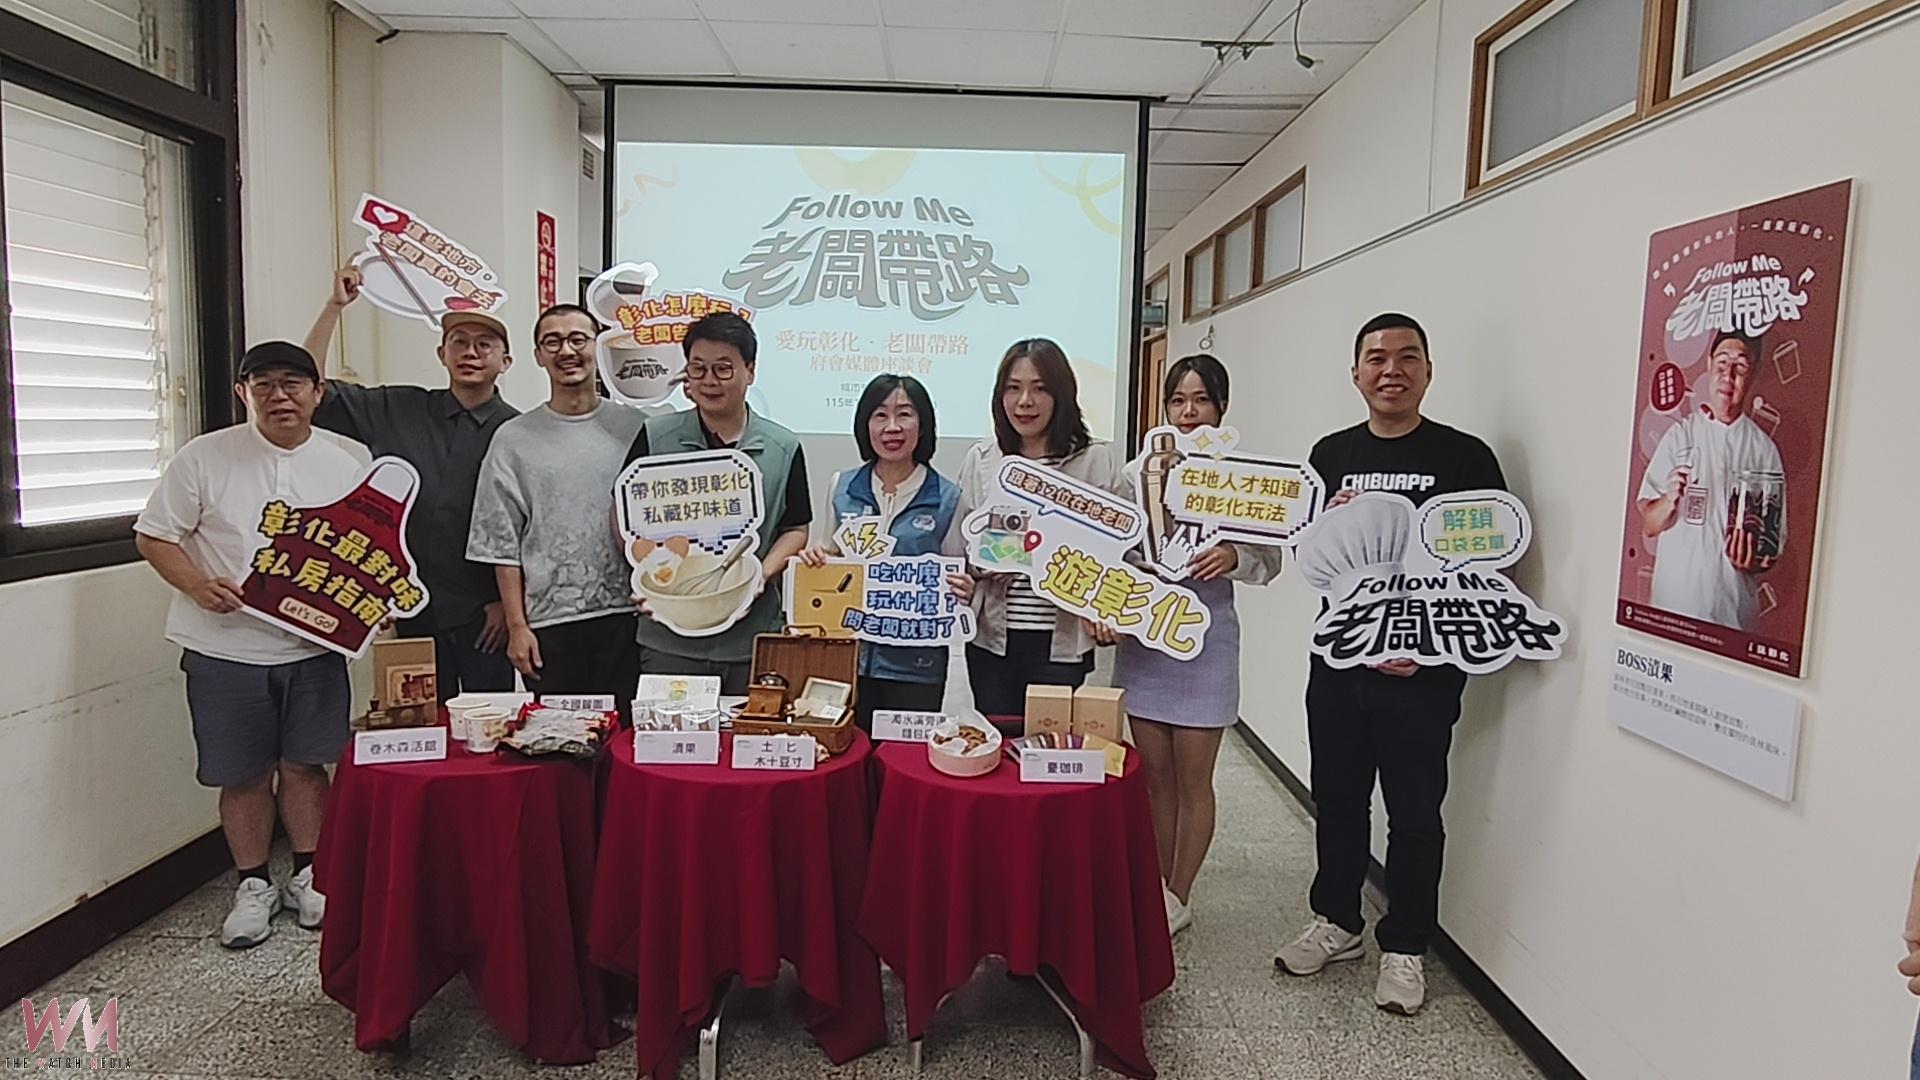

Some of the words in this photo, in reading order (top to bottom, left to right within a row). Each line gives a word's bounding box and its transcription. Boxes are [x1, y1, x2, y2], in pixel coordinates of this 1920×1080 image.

[762, 195, 903, 229] Follow
[914, 197, 974, 227] Me
[722, 225, 1029, 321] 老闆帶路
[1684, 259, 1749, 292] Follow
[1752, 254, 1782, 273] Me
[1666, 275, 1808, 338] 老闆帶路
[810, 355, 932, 373] 府會媒體座談會
[631, 471, 750, 500] 帶你發現彰化
[1180, 467, 1302, 499] 在地人才知道
[1341, 472, 1436, 492] CHIBUAPP
[643, 498, 742, 524] 私藏好味道
[1005, 466, 1135, 533] 跟著12位在地老闆
[1185, 492, 1286, 523] 的彰化玩法
[1442, 508, 1494, 531] 解鎖
[257, 501, 423, 610] 彰化最對味
[1435, 534, 1505, 552] 口袋名單
[254, 548, 389, 627] 私房指南
[1040, 545, 1203, 652] 遊彰化
[1340, 573, 1448, 602] Follow
[1457, 572, 1508, 592] Me
[283, 601, 310, 621] Let's
[314, 614, 335, 630] Go!
[1313, 596, 1561, 665] 老闆帶路
